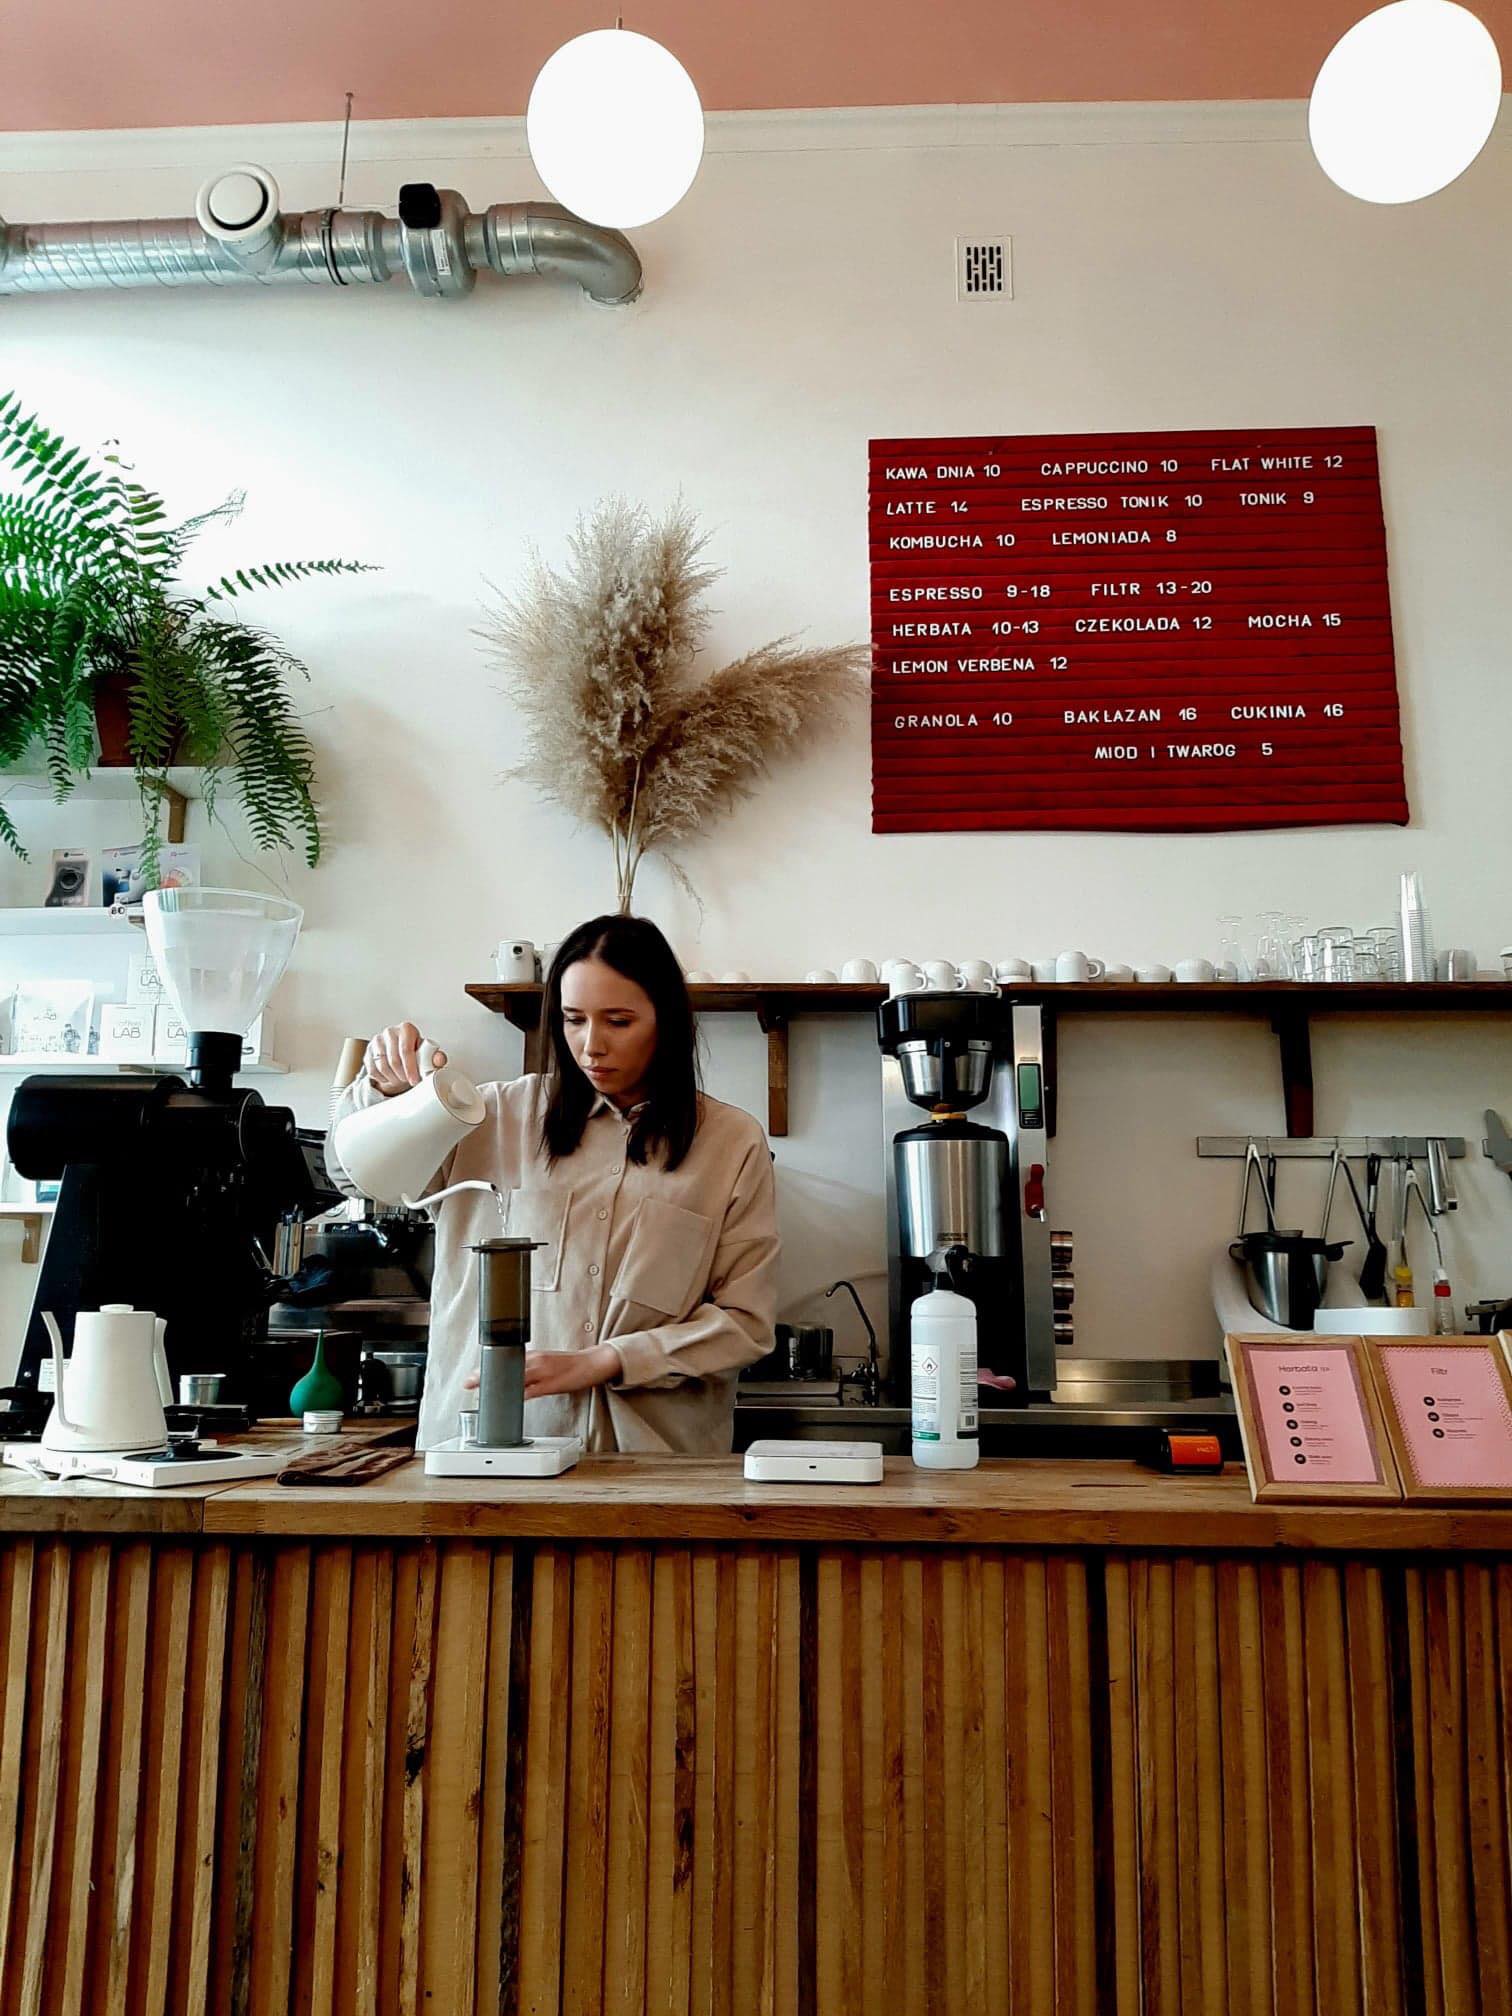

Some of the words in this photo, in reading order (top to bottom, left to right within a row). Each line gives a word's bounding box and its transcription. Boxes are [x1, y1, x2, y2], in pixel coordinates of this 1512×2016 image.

[1041, 460, 1148, 476] CAPPUCCINO
[1160, 459, 1178, 473] 10
[1211, 457, 1250, 471] FLAT
[1260, 455, 1313, 470] WHITE
[1324, 455, 1343, 468] 12
[885, 467, 928, 480] KAWA
[936, 465, 975, 479] DNIA
[983, 464, 1001, 477] 10
[1021, 496, 1108, 512] ESPRESSO
[1120, 495, 1169, 509] TONIK
[1184, 494, 1203, 507] 10
[1239, 492, 1287, 506] TONIK
[1303, 491, 1314, 504] 9
[886, 501, 937, 516] LATTE
[950, 500, 969, 513] 14
[889, 535, 983, 550] KOMBUCHA
[996, 533, 1015, 547] 10
[1052, 530, 1151, 546] LEMONIADA
[1166, 529, 1177, 543] 8
[889, 586, 983, 602] ESPRESSO
[1006, 584, 1051, 598] 9-18
[1091, 582, 1140, 597] FILTR
[1156, 580, 1212, 595] 13-20
[892, 622, 972, 637] HERBATA
[991, 620, 1039, 635] 10-13
[1075, 617, 1181, 633] CZEKOLADA
[1192, 616, 1212, 630] 12
[1248, 614, 1313, 628] MOCHA
[1322, 612, 1342, 627] 15
[892, 659, 948, 674] LEMON
[957, 657, 1035, 673] VERBENA
[1049, 656, 1068, 670] 12
[1178, 707, 1197, 721] 16
[1230, 704, 1306, 720] CUKINIA
[1323, 703, 1344, 717] 16
[894, 713, 978, 729] GRANOLA
[992, 712, 1013, 726] 10
[1094, 745, 1138, 760] MIOD
[1150, 746, 1156, 759] I
[1167, 743, 1236, 758] TWAROG
[1261, 742, 1273, 756] 5
[112, 1026, 142, 1039] LAB
